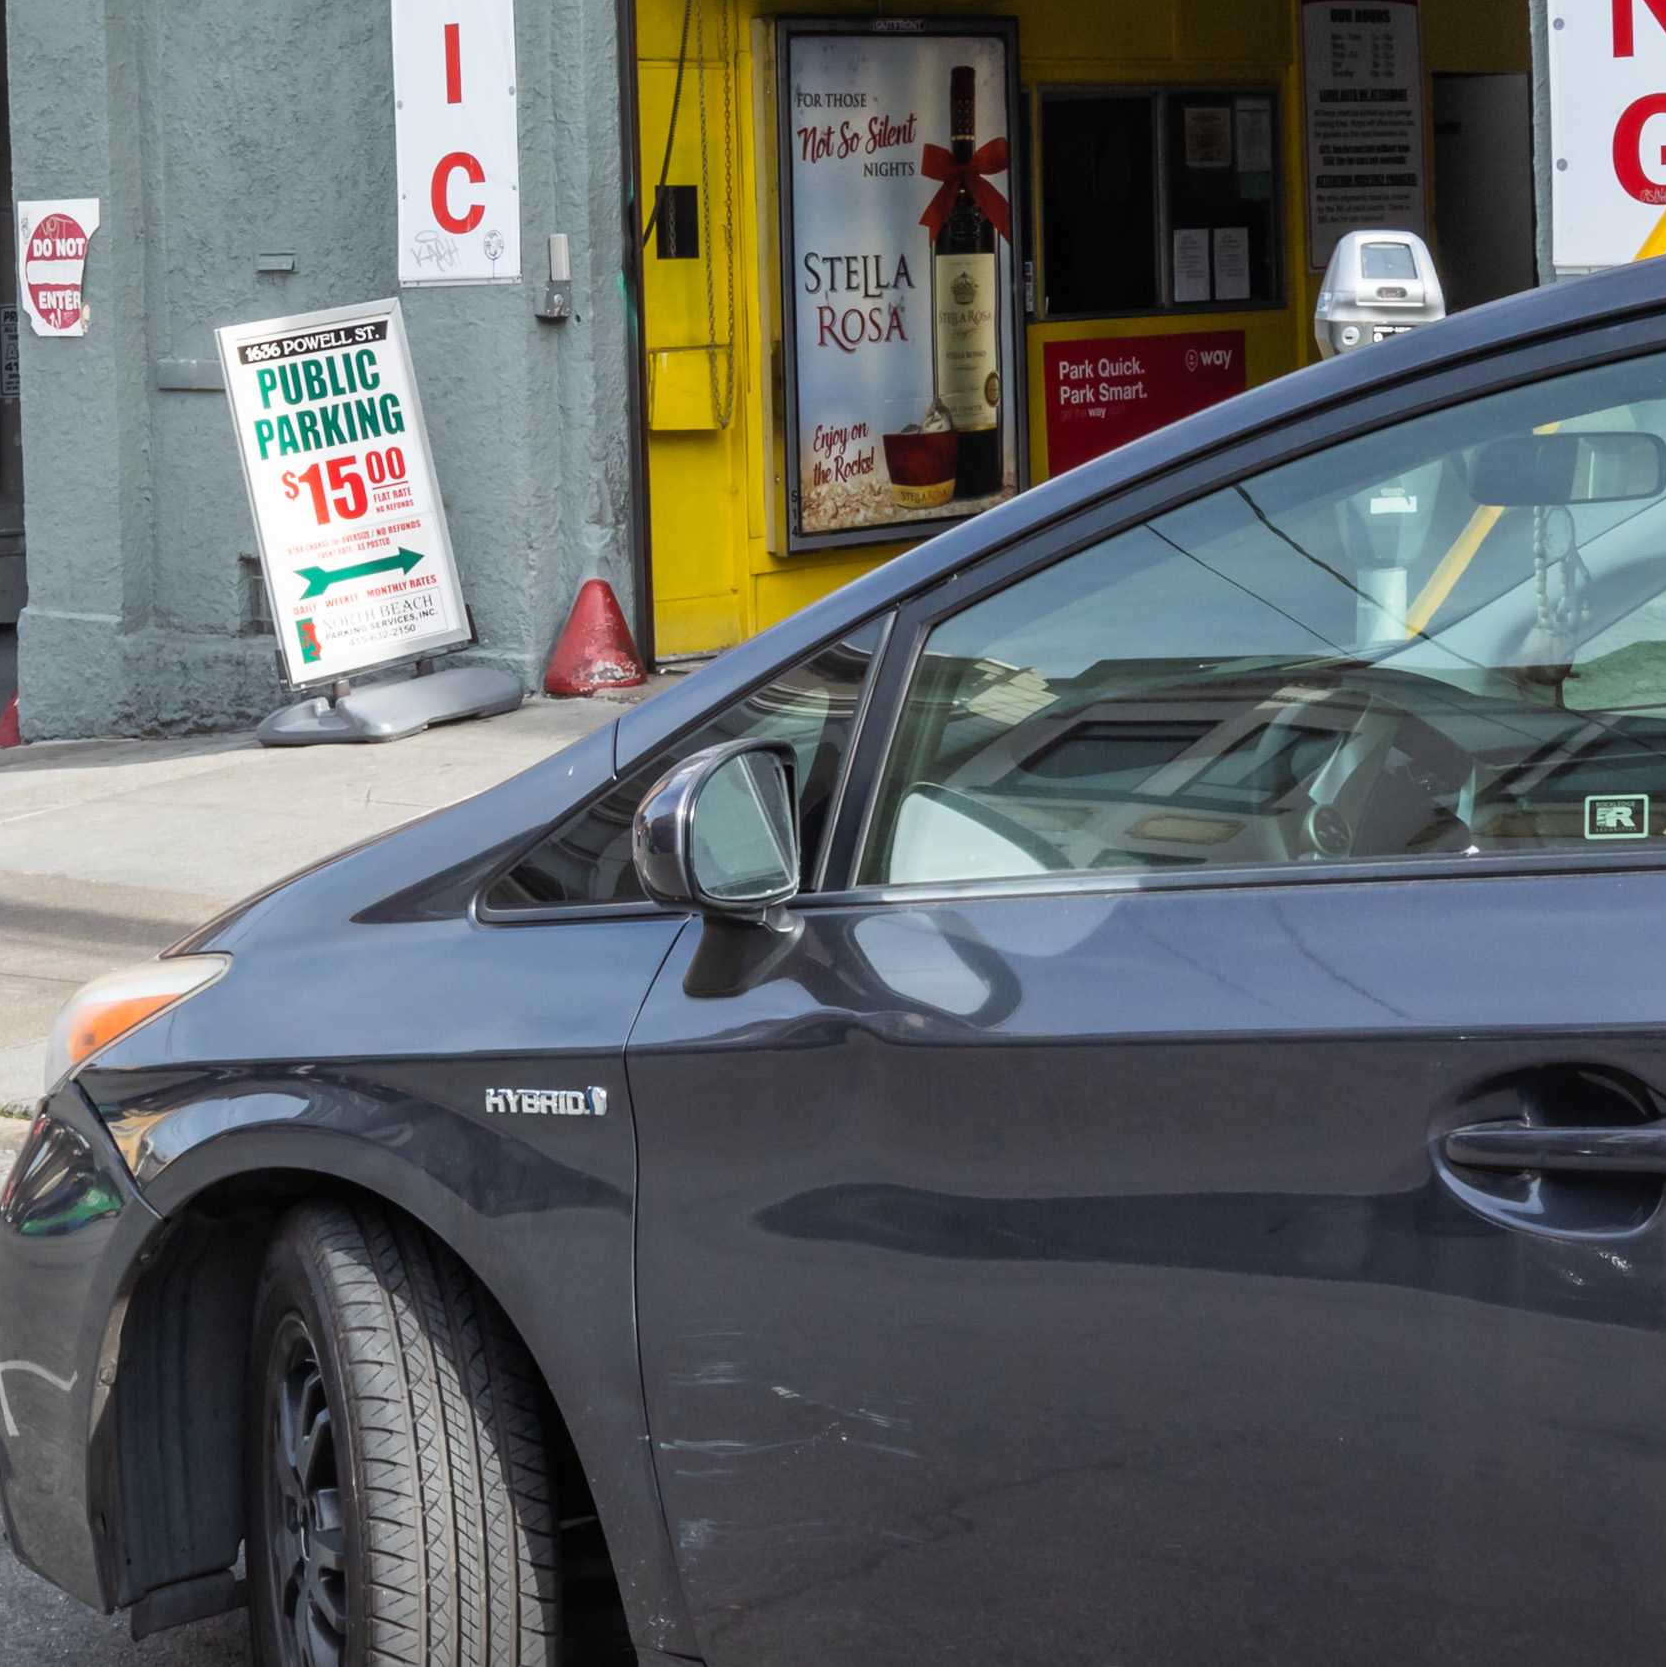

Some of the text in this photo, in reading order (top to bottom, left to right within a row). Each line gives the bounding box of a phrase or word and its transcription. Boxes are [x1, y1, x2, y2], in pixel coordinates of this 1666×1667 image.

[797, 93, 868, 108] FOR THOSE
[797, 113, 917, 164] Not So Silent
[863, 161, 916, 177] NIGHTS
[33, 238, 85, 257] DO NOT
[803, 252, 916, 299] STELLA
[39, 290, 81, 310] ENTER
[816, 305, 909, 354] ROSA
[245, 326, 379, 361] 1636 POWELL ST.
[1059, 356, 1145, 380] Park Quick.
[1200, 349, 1233, 370] way
[256, 349, 380, 409] PUBLIC
[1060, 381, 1148, 405] Park Smart.
[254, 393, 405, 460] PARKING
[813, 422, 868, 459] Enjoy on
[813, 446, 875, 486] the Rocks!
[373, 489, 412, 503] FLAT RATE
[376, 500, 414, 513] NO REFUNDS
[376, 526, 386, 536] NO
[388, 519, 421, 534] REFUNDS
[367, 537, 391, 550] POSTED
[367, 581, 409, 598] MONTHLY
[410, 574, 437, 589] RATES
[380, 594, 435, 618] BEACH
[485, 1088, 585, 1115] HYBRID
